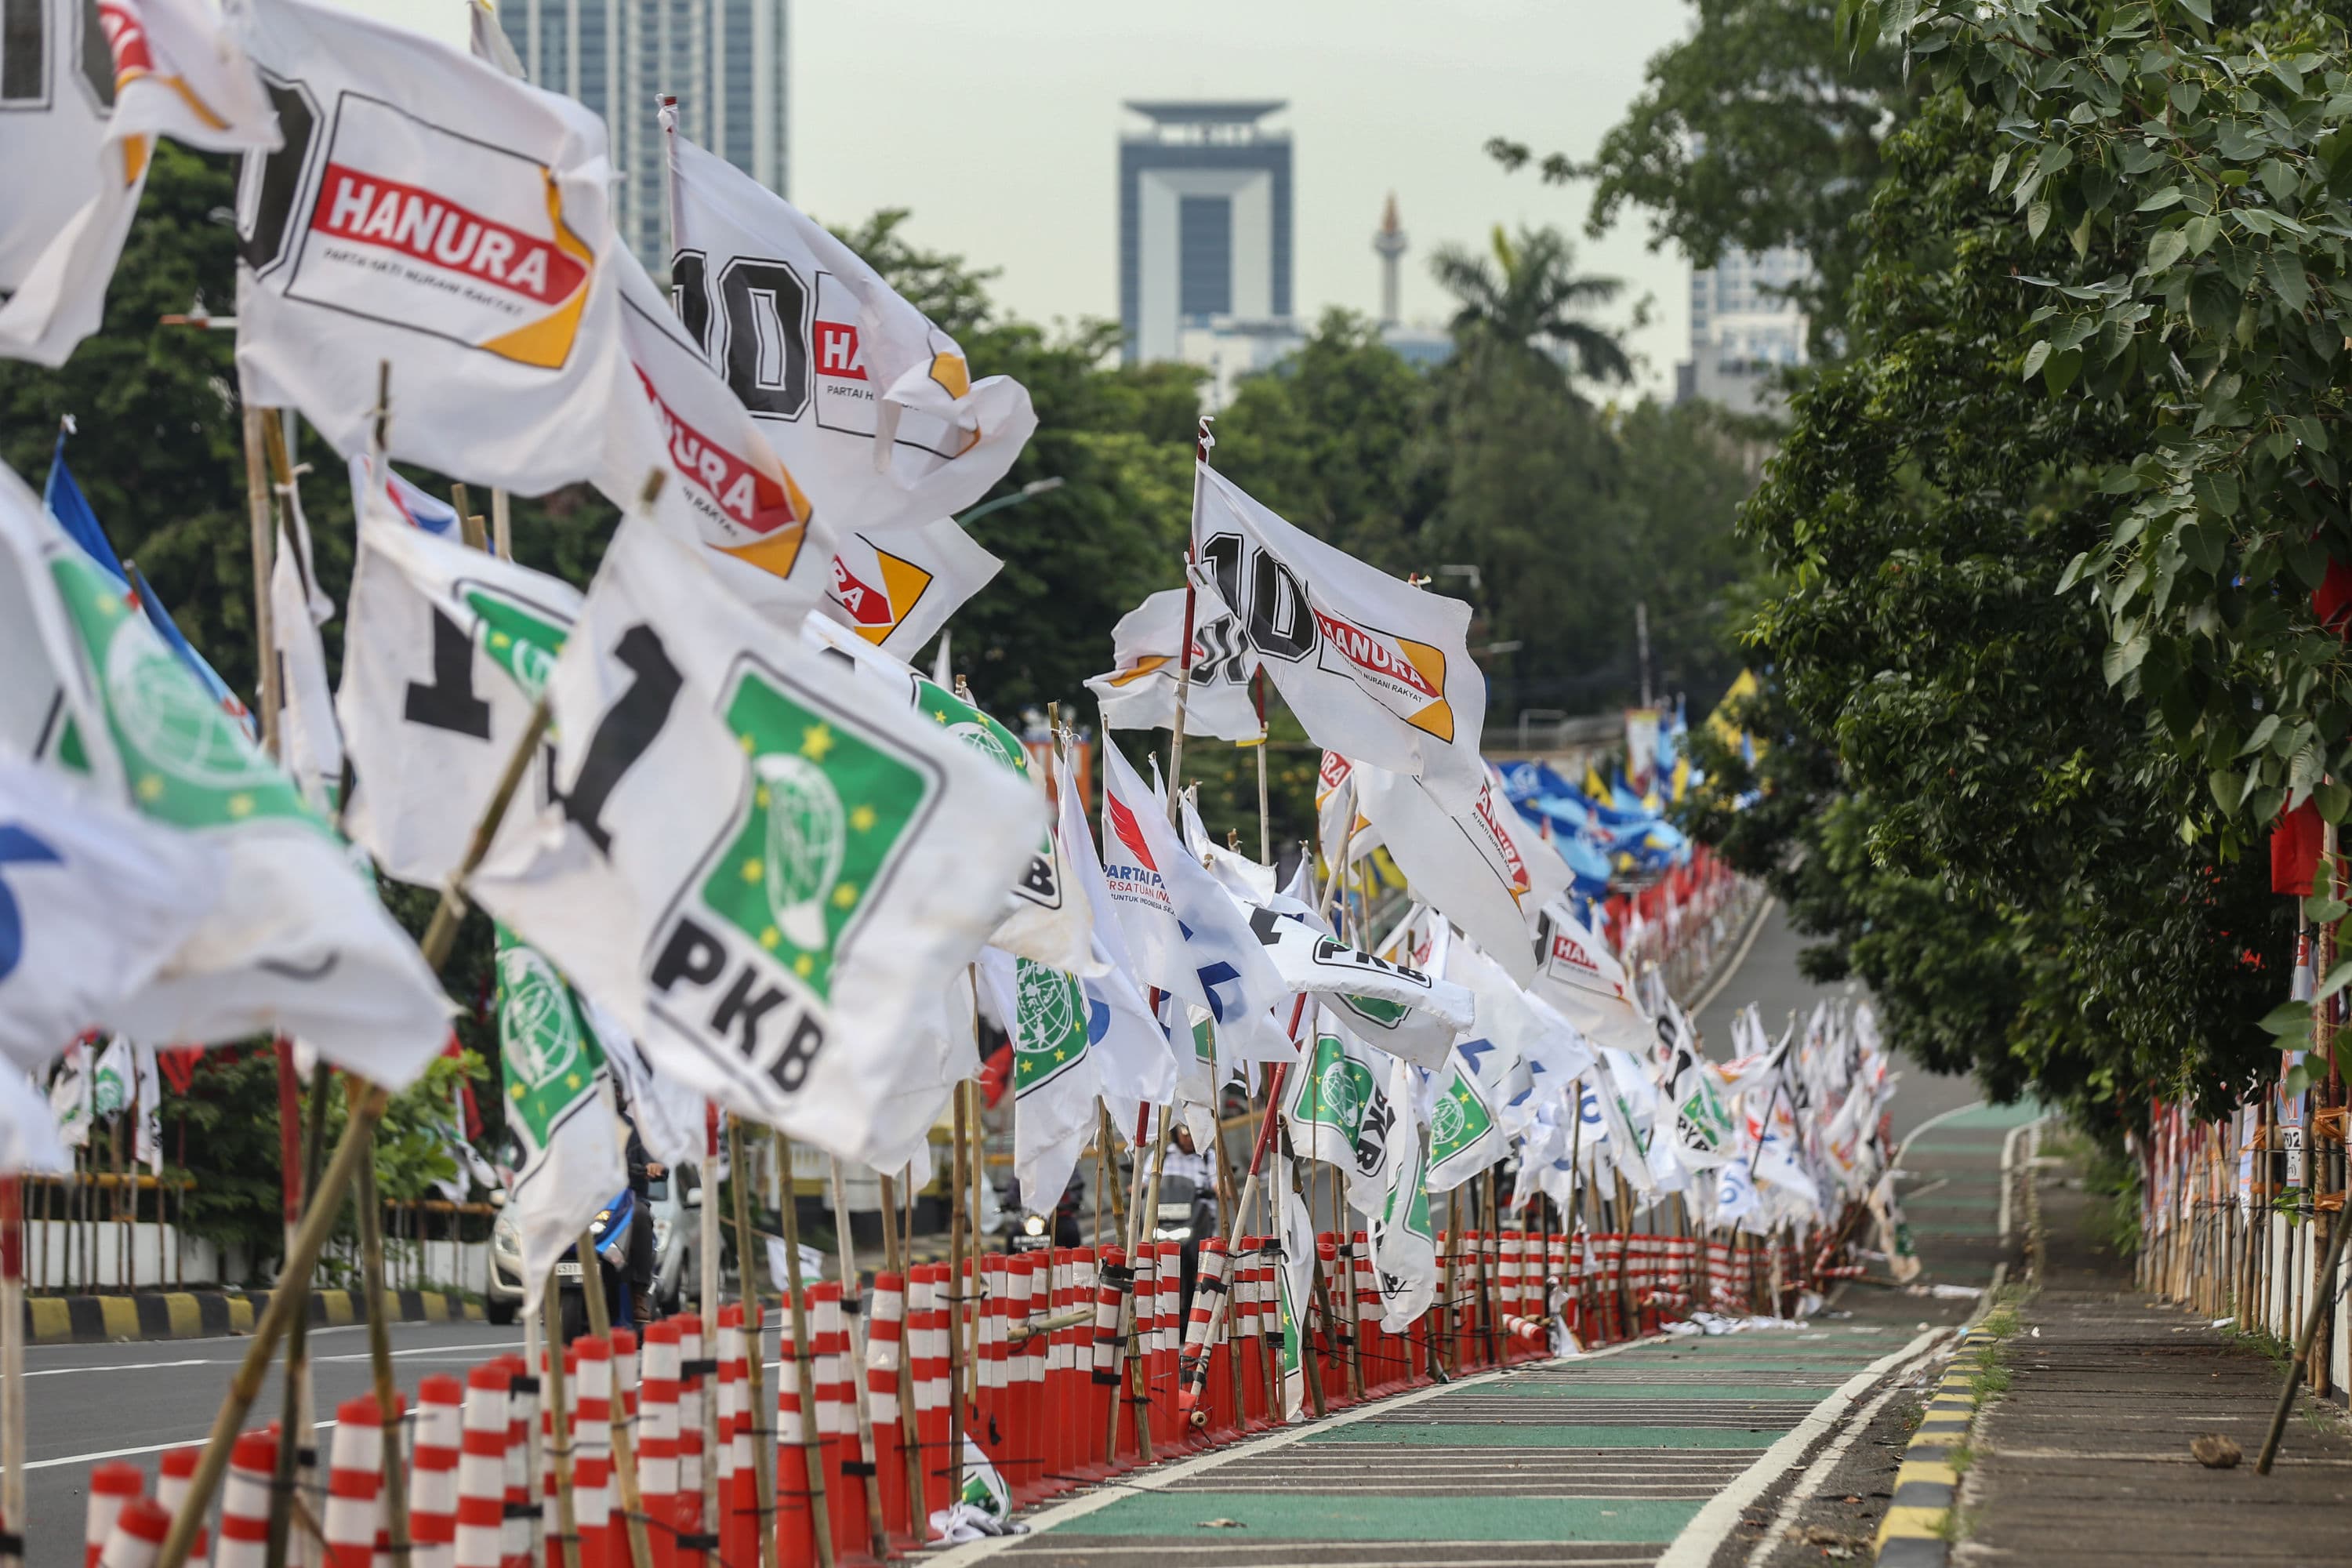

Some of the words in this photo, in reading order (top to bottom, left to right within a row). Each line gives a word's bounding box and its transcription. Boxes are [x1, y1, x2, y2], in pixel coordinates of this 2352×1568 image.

[328, 176, 548, 295] HANURA
[827, 385, 862, 399] PARTAI
[666, 419, 756, 520] URA
[1202, 532, 1318, 663] 10
[1319, 616, 1427, 690] HANURA
[1363, 672, 1390, 689] NURANI
[1392, 684, 1423, 703] RAKYAT
[1106, 880, 1154, 898] RSATUAN
[652, 917, 823, 1093] PKB
